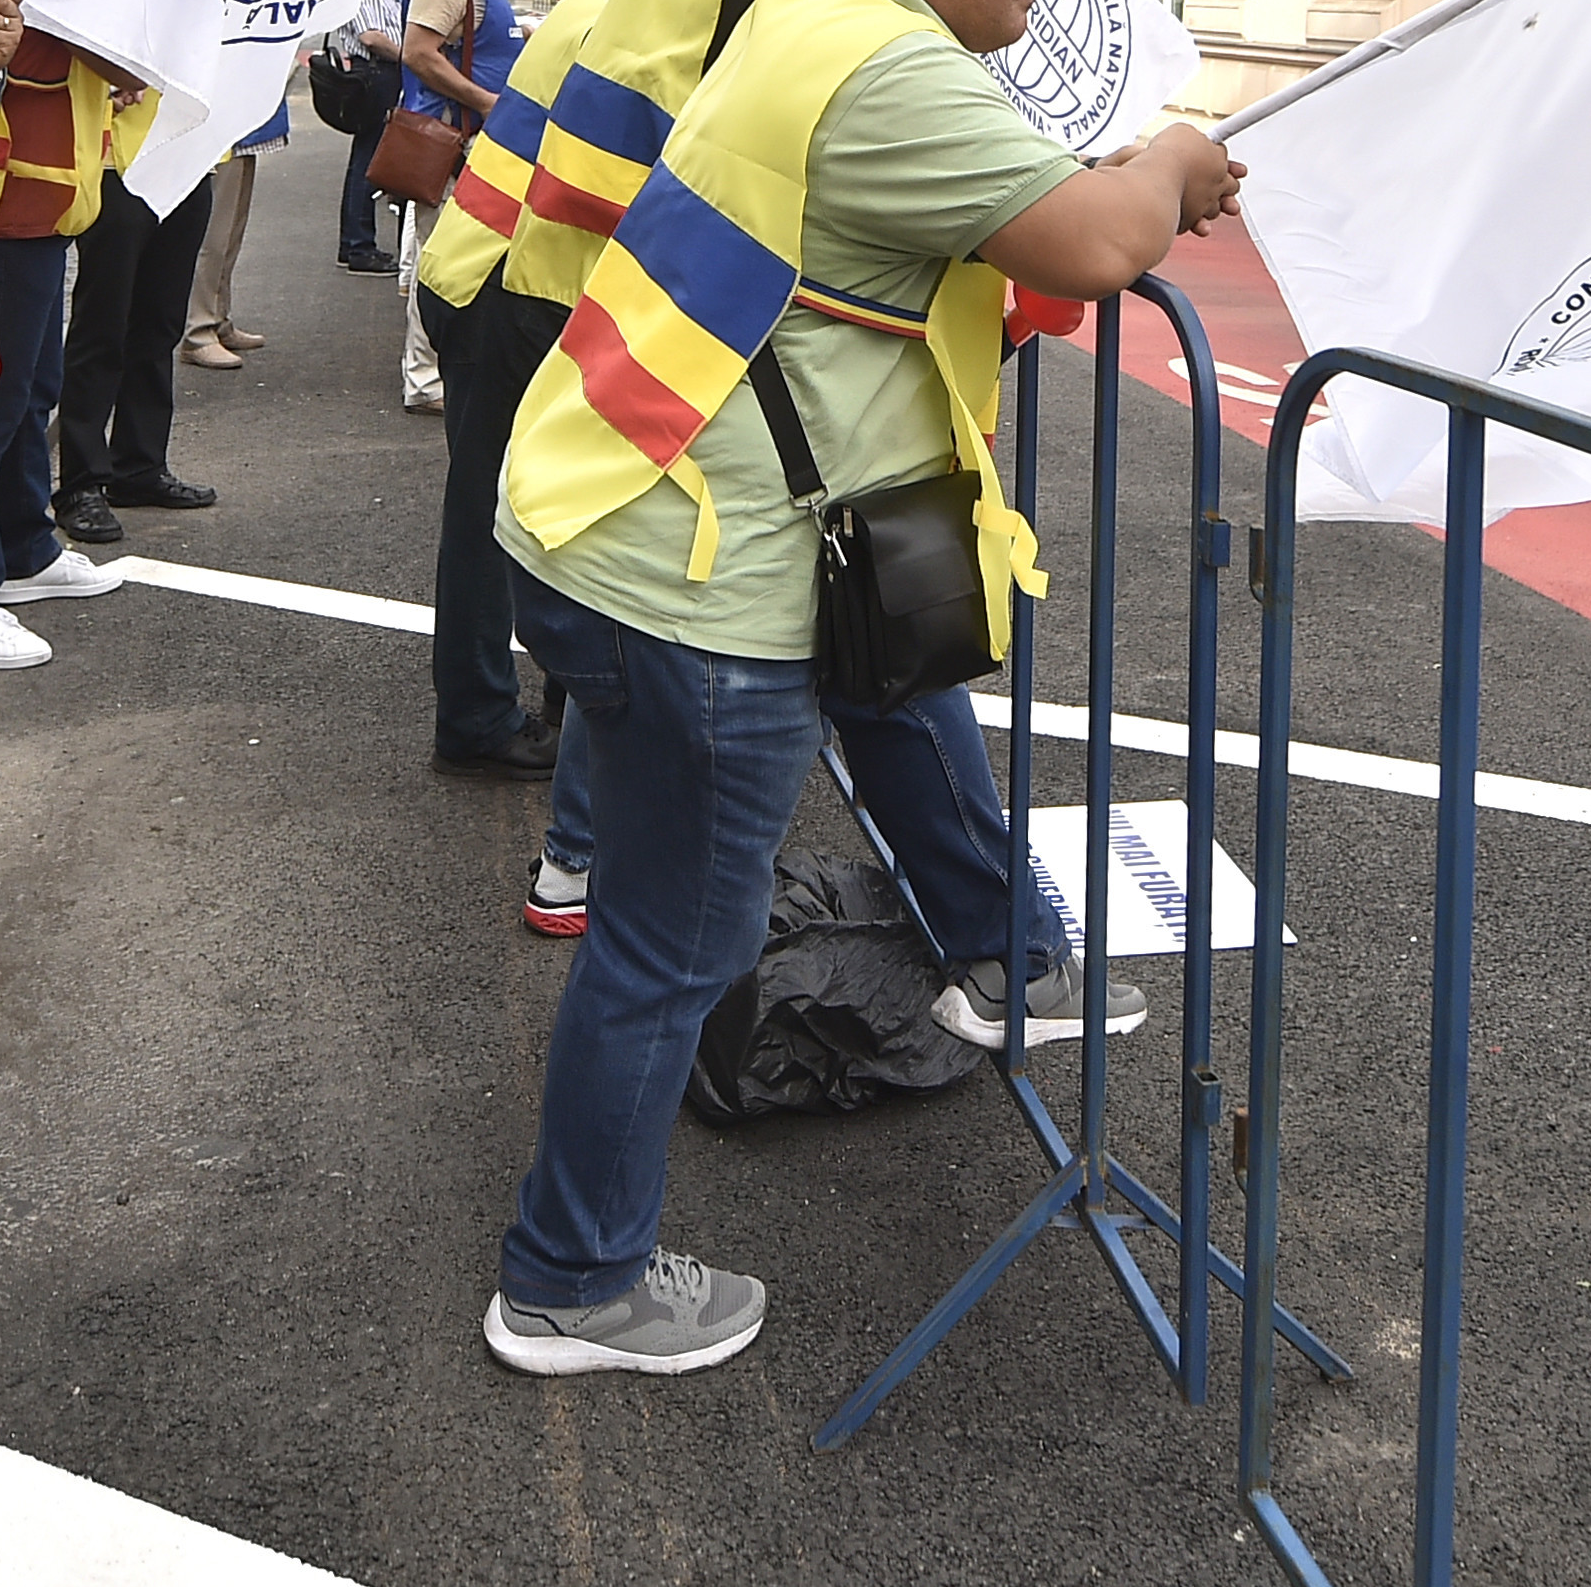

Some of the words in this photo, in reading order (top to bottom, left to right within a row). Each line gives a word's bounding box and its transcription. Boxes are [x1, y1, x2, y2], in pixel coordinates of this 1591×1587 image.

[1029, 0, 1084, 85] RIDIAN
[1062, 43, 1123, 144] NAȚIONALĂ
[1110, 835, 1161, 867] MAI
